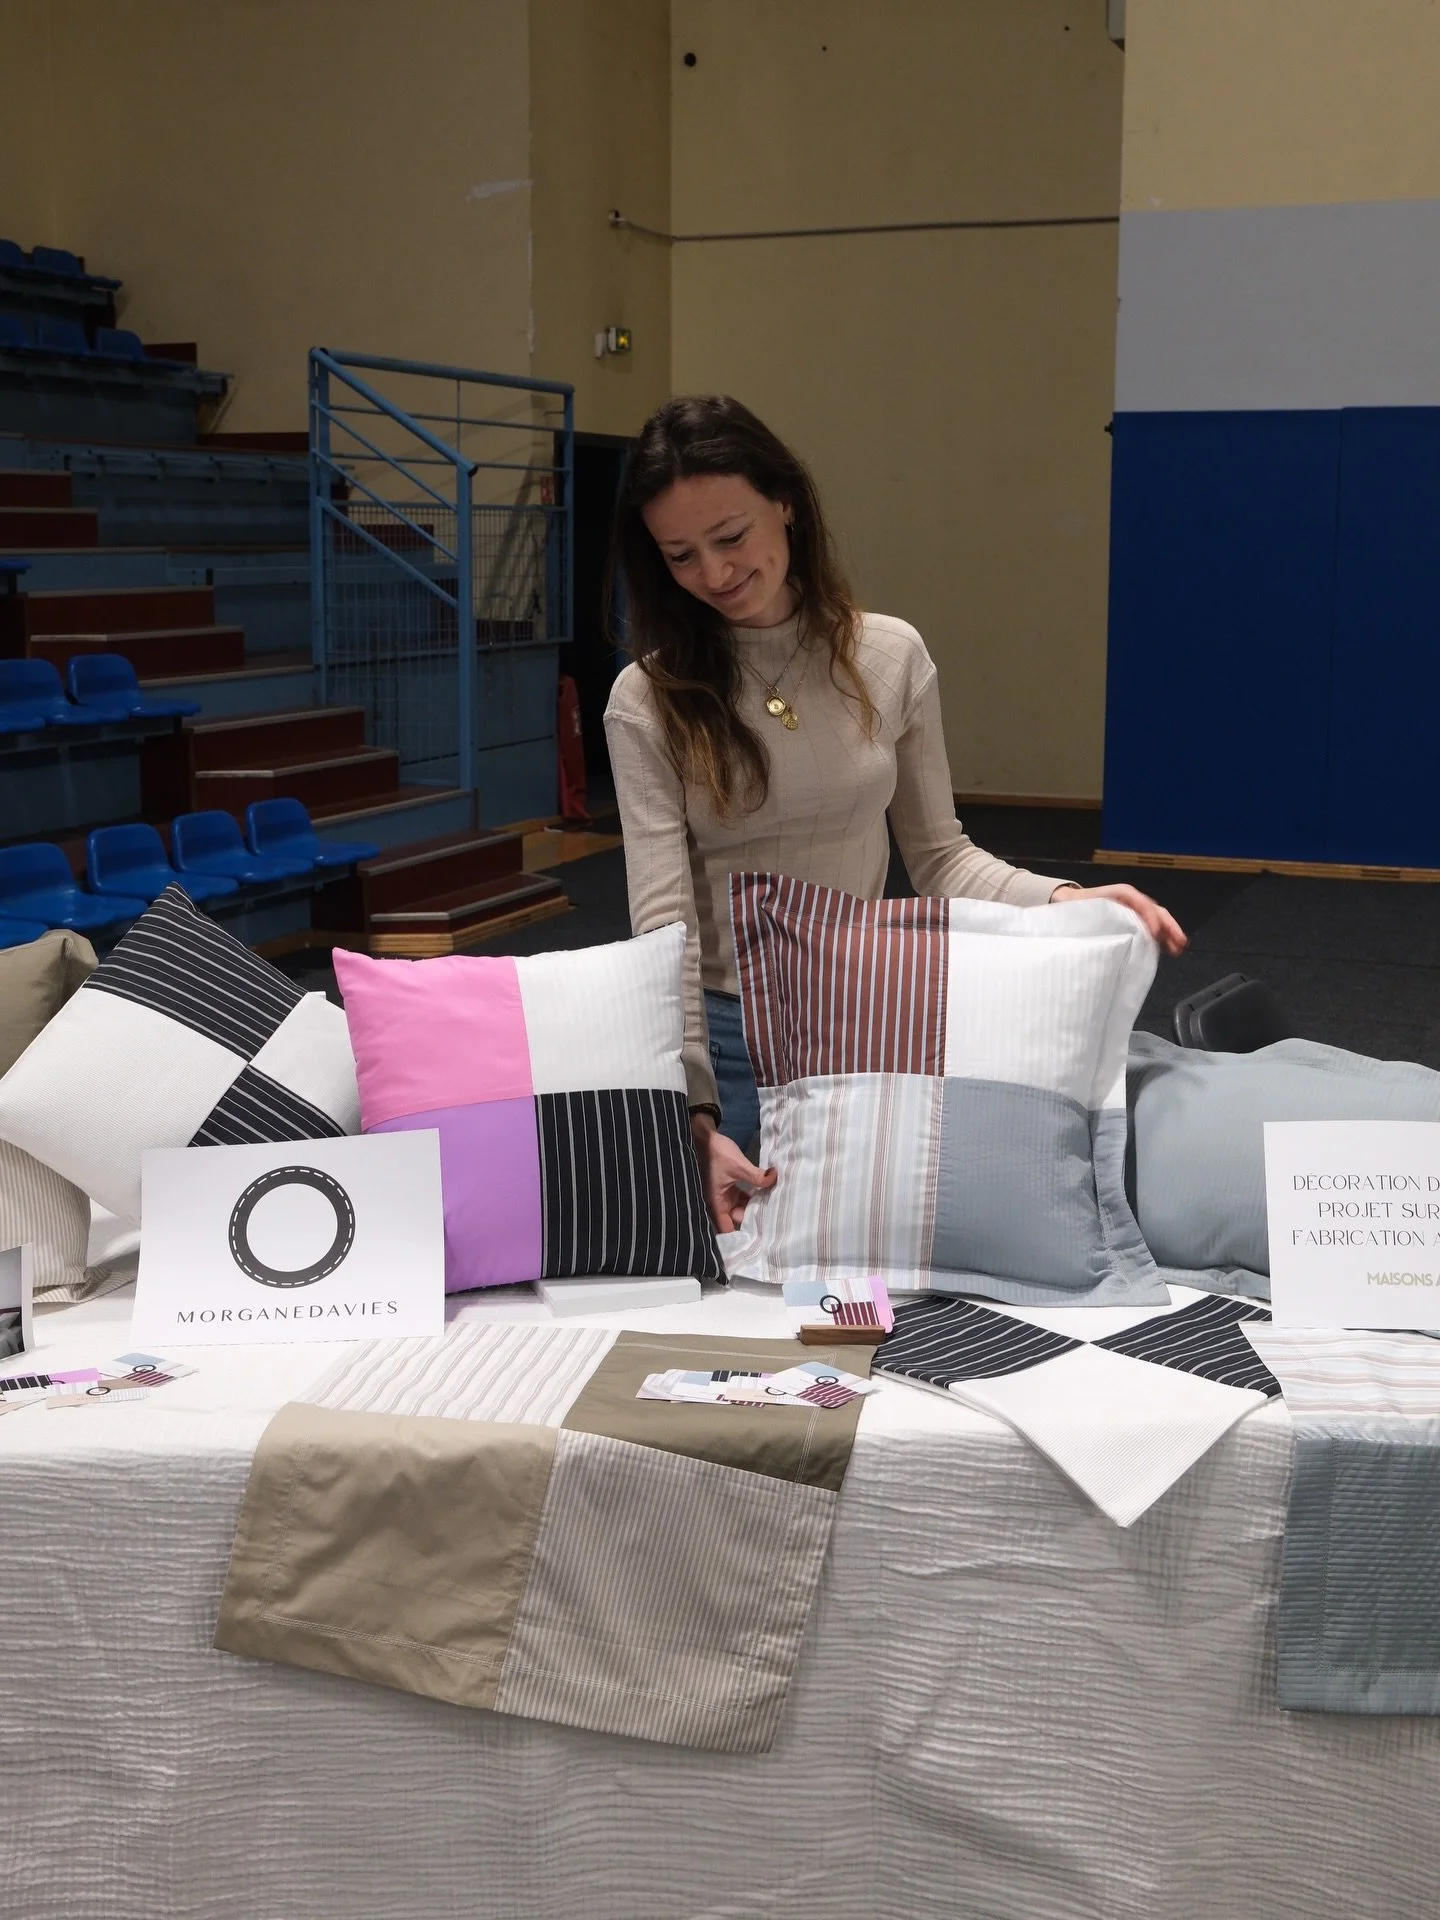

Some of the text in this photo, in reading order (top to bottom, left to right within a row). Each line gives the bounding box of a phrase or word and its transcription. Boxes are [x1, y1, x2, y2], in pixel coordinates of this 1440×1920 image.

[1293, 1173, 1421, 1192] DÉCORATION
[1318, 1201, 1440, 1220] PROJET SUR
[1292, 1229, 1425, 1247] FABRICATION
[1366, 1272, 1434, 1287] MAISONS
[176, 1300, 398, 1324] MORGANEDAVIES
